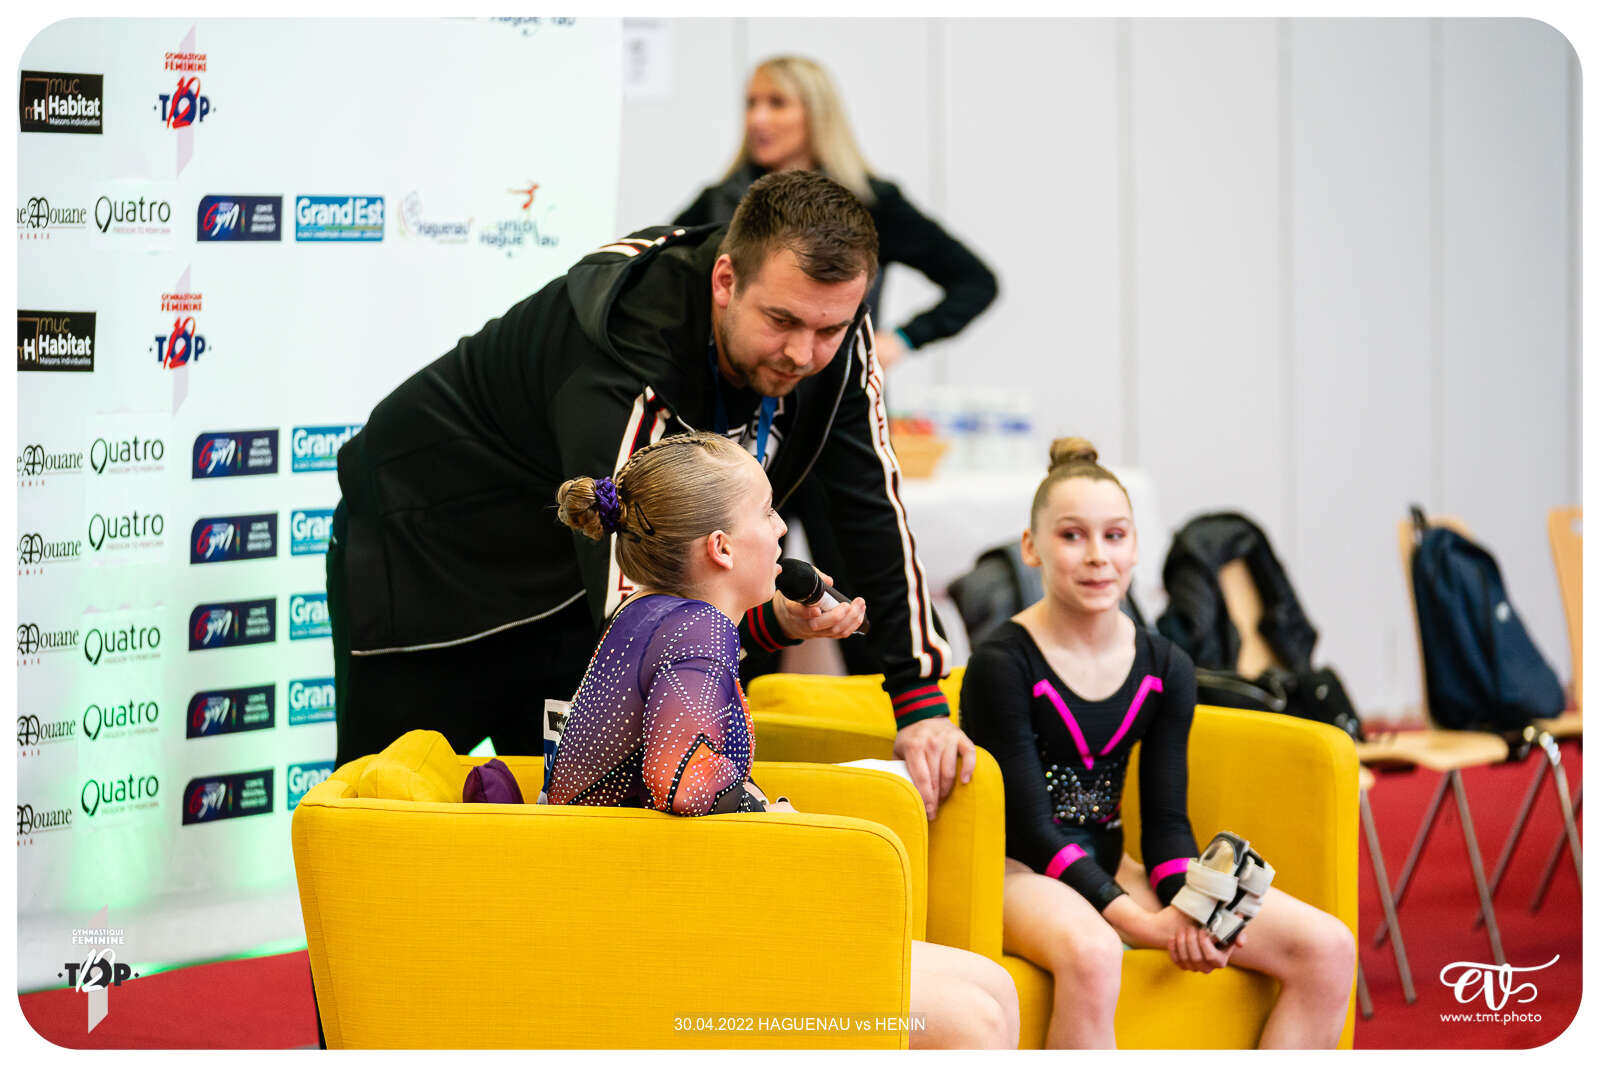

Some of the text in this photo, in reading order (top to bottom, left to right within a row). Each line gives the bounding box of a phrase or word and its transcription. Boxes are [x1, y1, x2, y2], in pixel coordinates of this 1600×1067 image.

[48, 78, 80, 94] muc
[48, 93, 101, 117] Habitat
[158, 88, 210, 123] TOP
[94, 195, 171, 233] Quatro
[39, 316, 71, 334] muc
[38, 332, 91, 356] Habitat
[155, 328, 206, 362] TOP
[90, 435, 165, 475] Quatro
[88, 510, 164, 551] Quatro
[84, 624, 161, 666] Quatro
[290, 682, 335, 711] Gran
[83, 699, 159, 741] Quatro
[81, 773, 159, 817] Quatro
